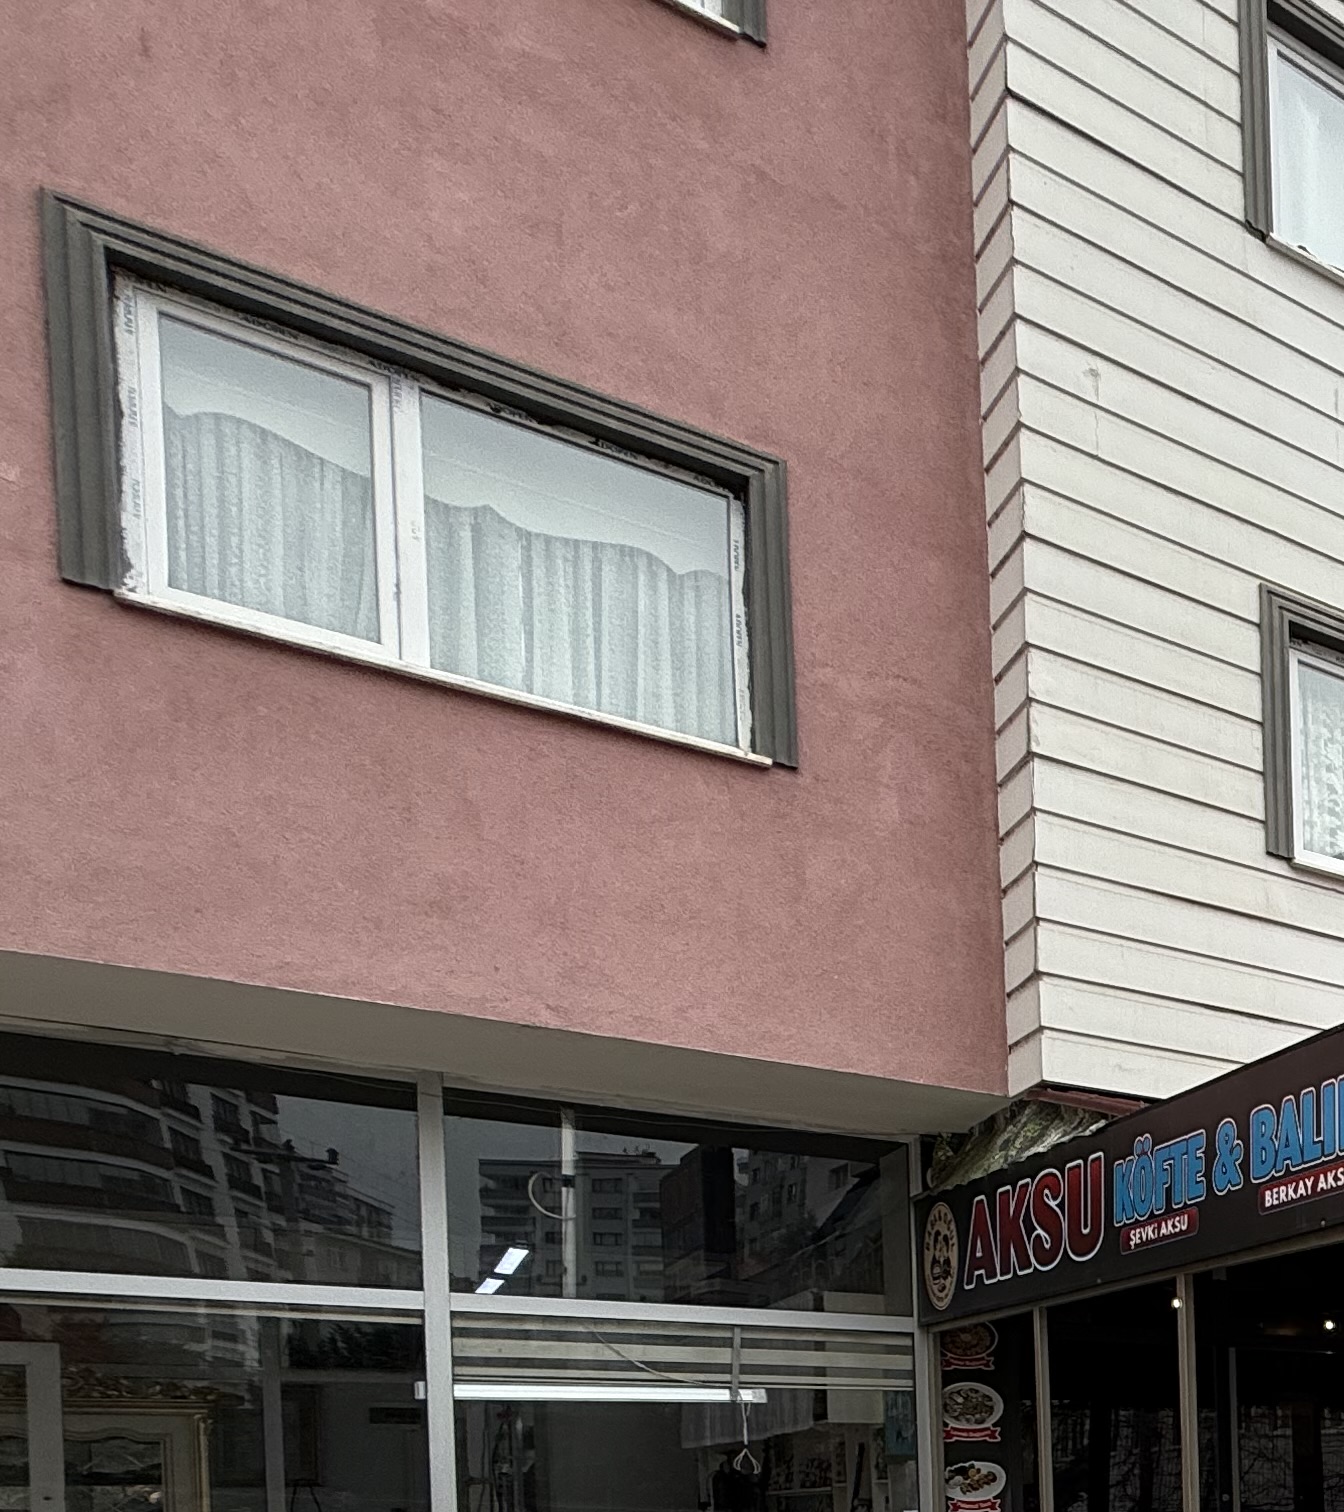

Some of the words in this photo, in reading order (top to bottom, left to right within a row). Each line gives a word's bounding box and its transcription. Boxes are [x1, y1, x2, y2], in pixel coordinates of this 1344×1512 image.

[964, 1151, 1105, 1290] AKSU
[1113, 1129, 1206, 1228] KÖFTE
[1213, 1117, 1244, 1196] &
[1264, 1178, 1315, 1209] BERKAY
[1159, 1214, 1188, 1236] AKSU
